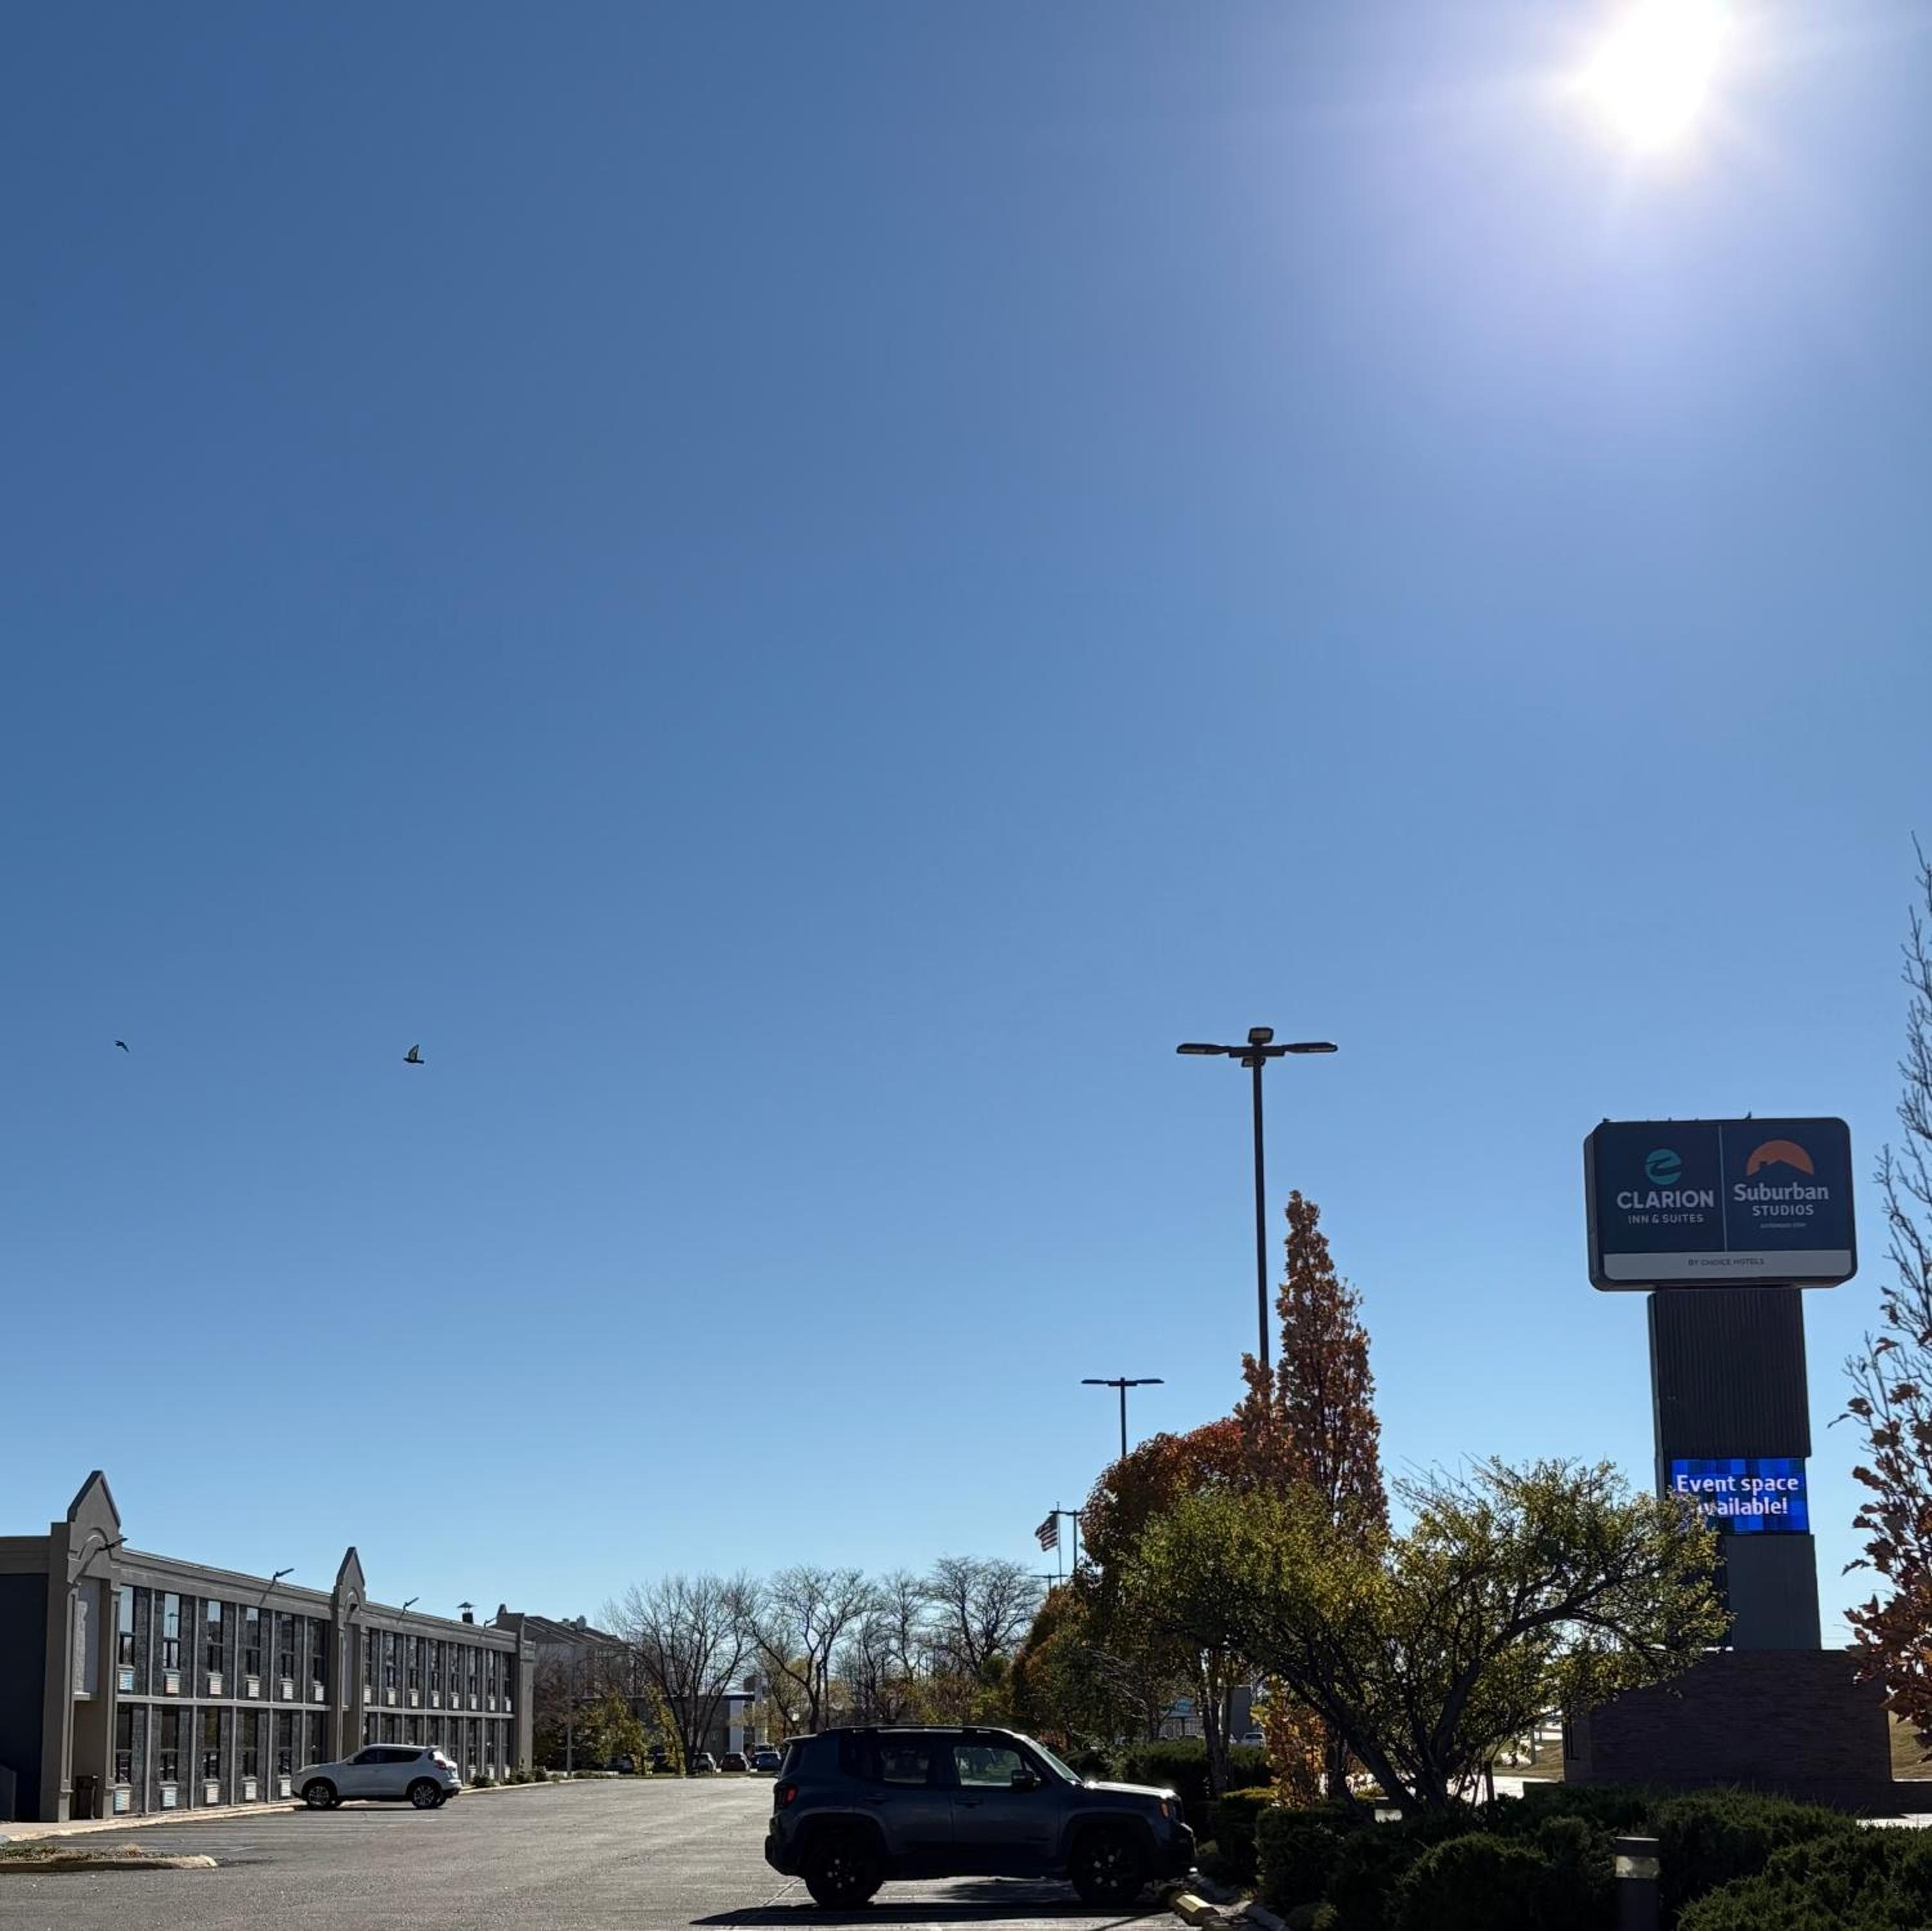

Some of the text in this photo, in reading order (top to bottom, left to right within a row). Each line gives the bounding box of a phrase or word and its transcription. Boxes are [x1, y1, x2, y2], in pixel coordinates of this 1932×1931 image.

[1617, 1190, 1714, 1209] CLARION
[1734, 1181, 1829, 1201] Suburban
[1628, 1213, 1704, 1224] INN & SUITES
[1752, 1204, 1814, 1216] STUDIOS
[1676, 1474, 1799, 1496] Event space
